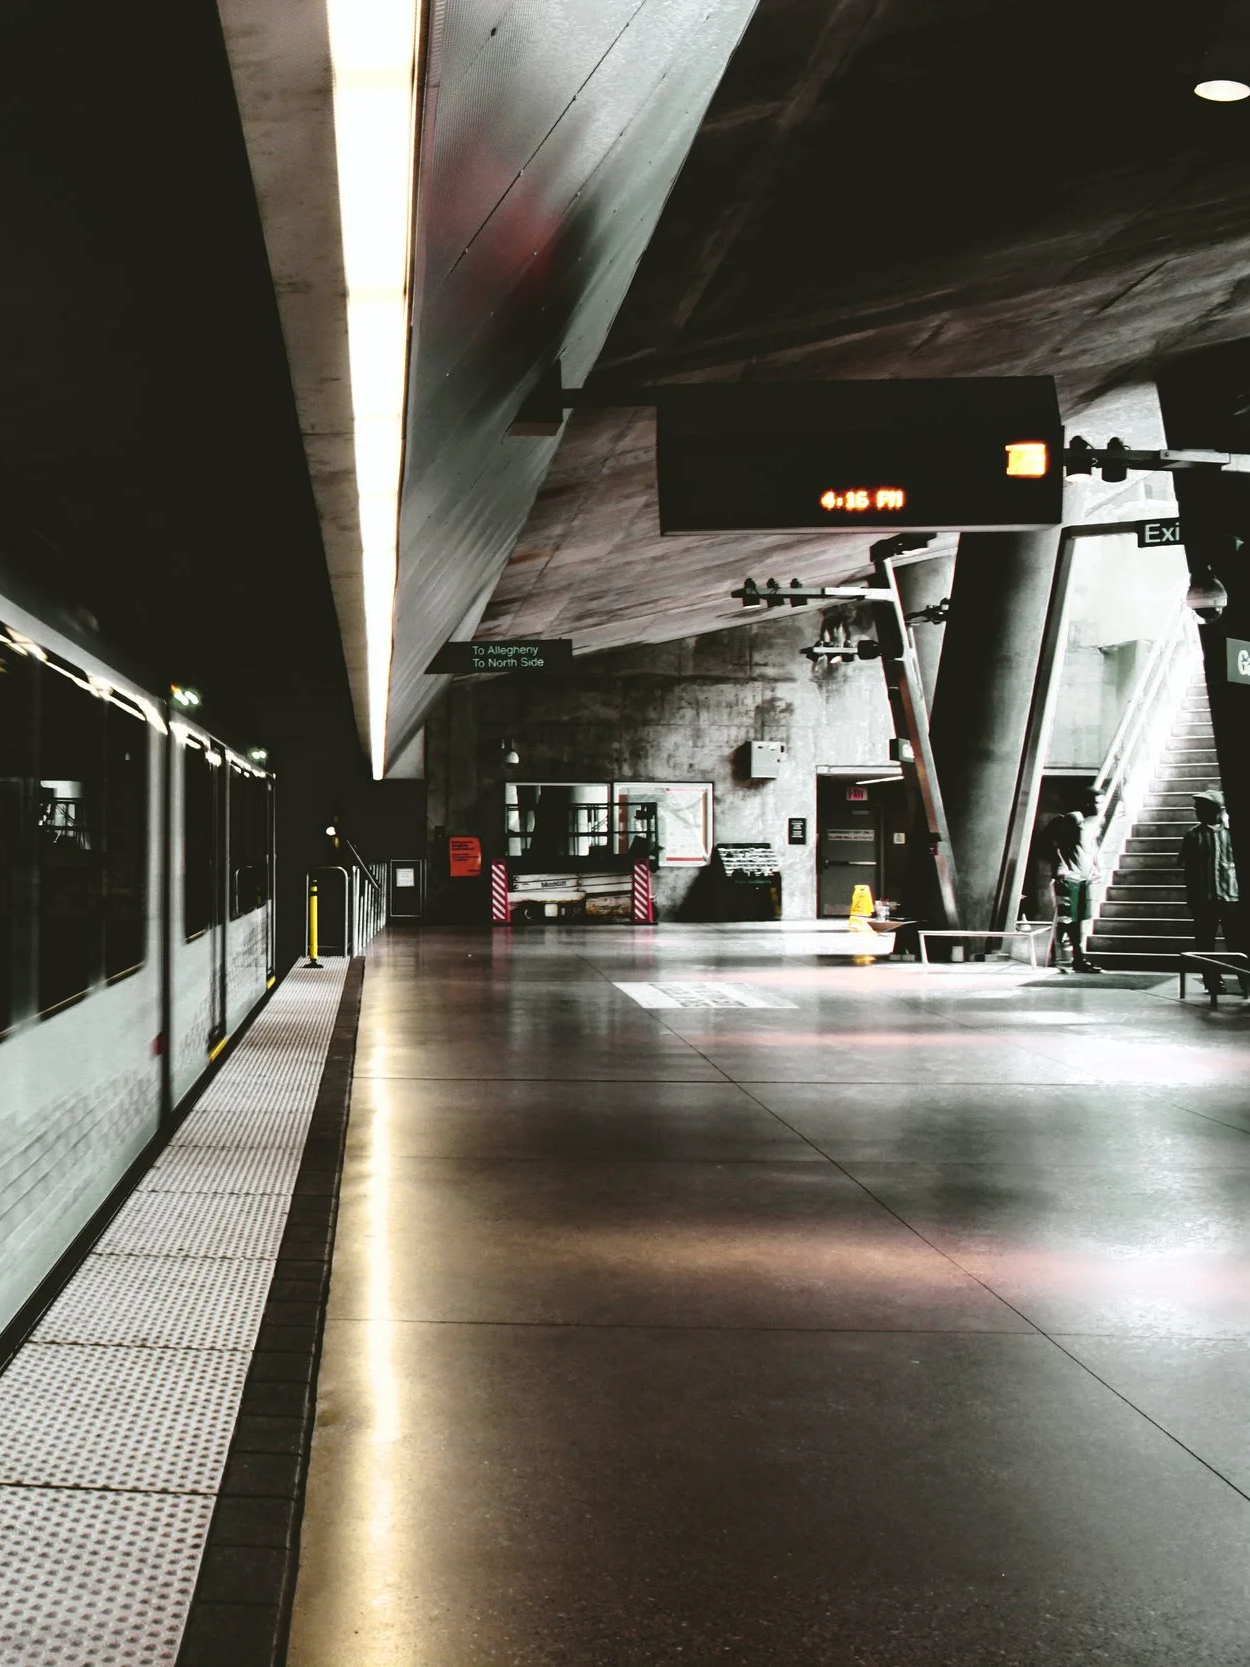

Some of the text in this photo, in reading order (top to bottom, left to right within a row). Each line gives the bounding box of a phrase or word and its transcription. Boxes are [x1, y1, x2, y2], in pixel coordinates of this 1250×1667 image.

[820, 489, 904, 511] 4:16 PM
[1144, 522, 1181, 543] Exi
[472, 645, 539, 657] To Allegheny
[472, 656, 545, 668] To North Side
